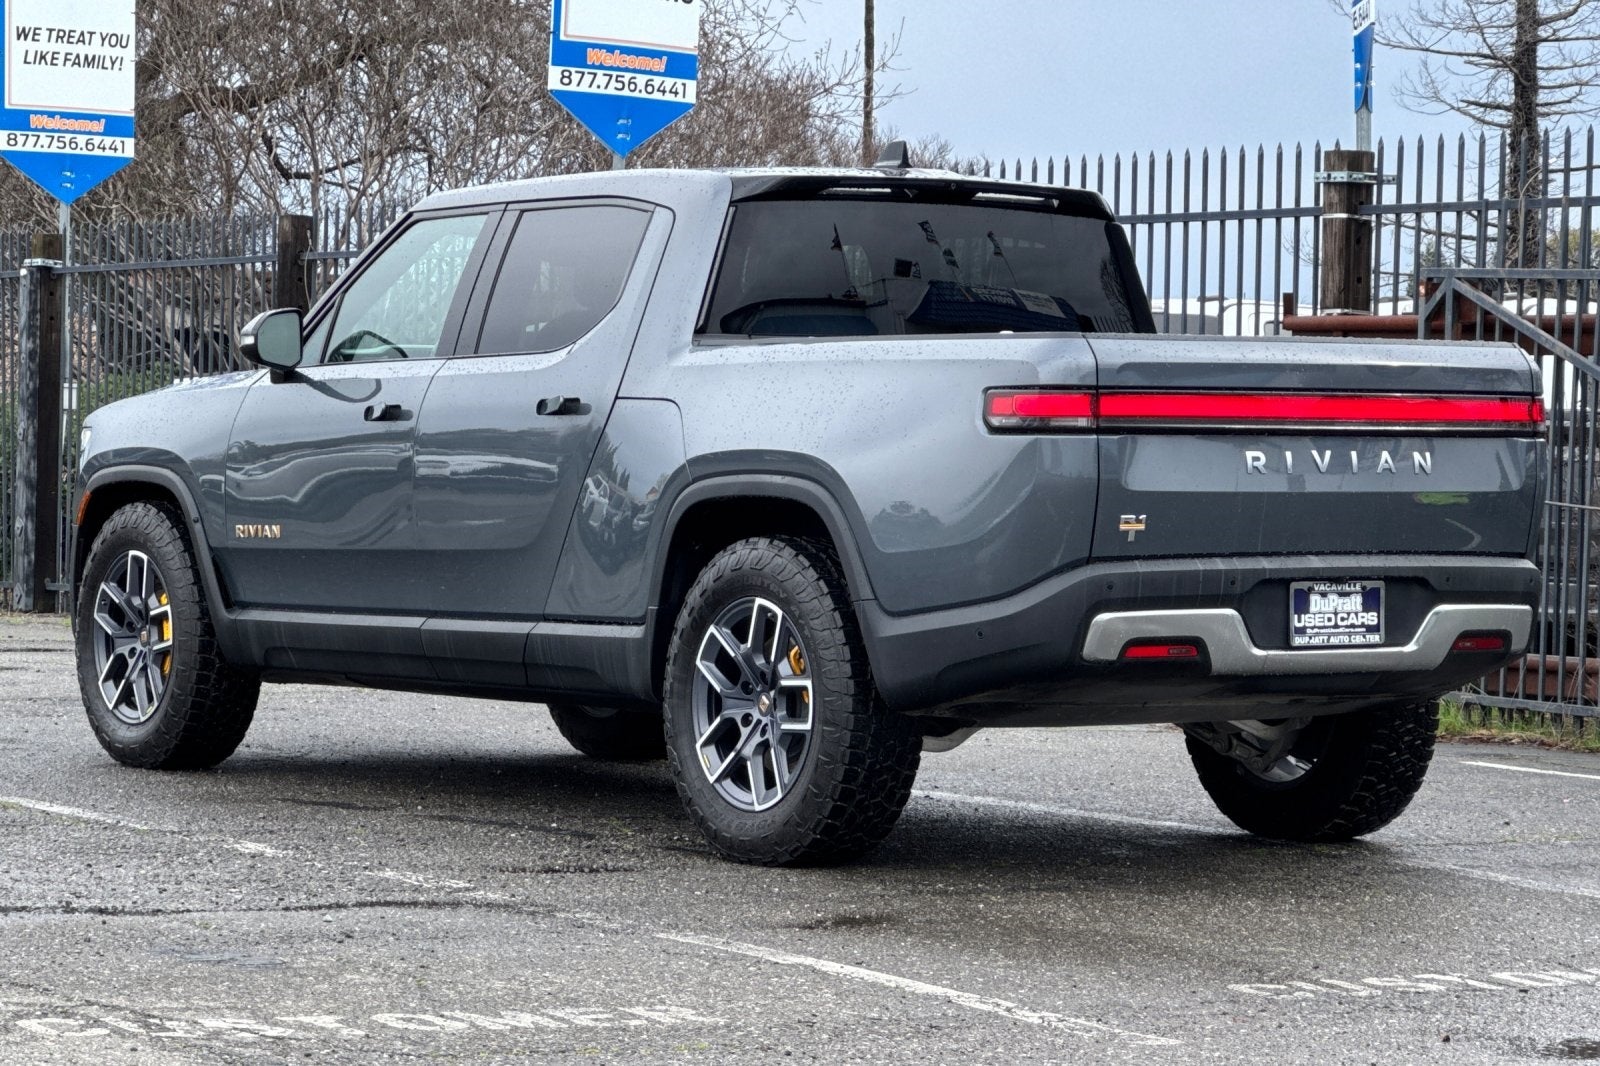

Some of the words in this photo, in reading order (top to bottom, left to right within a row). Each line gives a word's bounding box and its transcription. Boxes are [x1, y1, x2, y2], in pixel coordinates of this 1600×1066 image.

[16, 26, 42, 42] WE
[46, 28, 96, 46] TREAT
[99, 32, 130, 49] YOU
[23, 49, 60, 67] LIKE
[63, 52, 123, 71] FAMILY!
[587, 48, 667, 72] Welcome!
[560, 69, 687, 99] 877.756.6441
[30, 114, 105, 132] Welcome!
[6, 133, 126, 154] 877.756.6441
[1245, 450, 1432, 474] RIVIAN
[235, 524, 281, 539] RIVIAN
[1313, 583, 1362, 591] VACAVILLE
[1309, 593, 1363, 613] DuPratt
[1294, 613, 1336, 627] USED
[1337, 612, 1379, 625] CARS
[1330, 635, 1350, 643] AUTO
